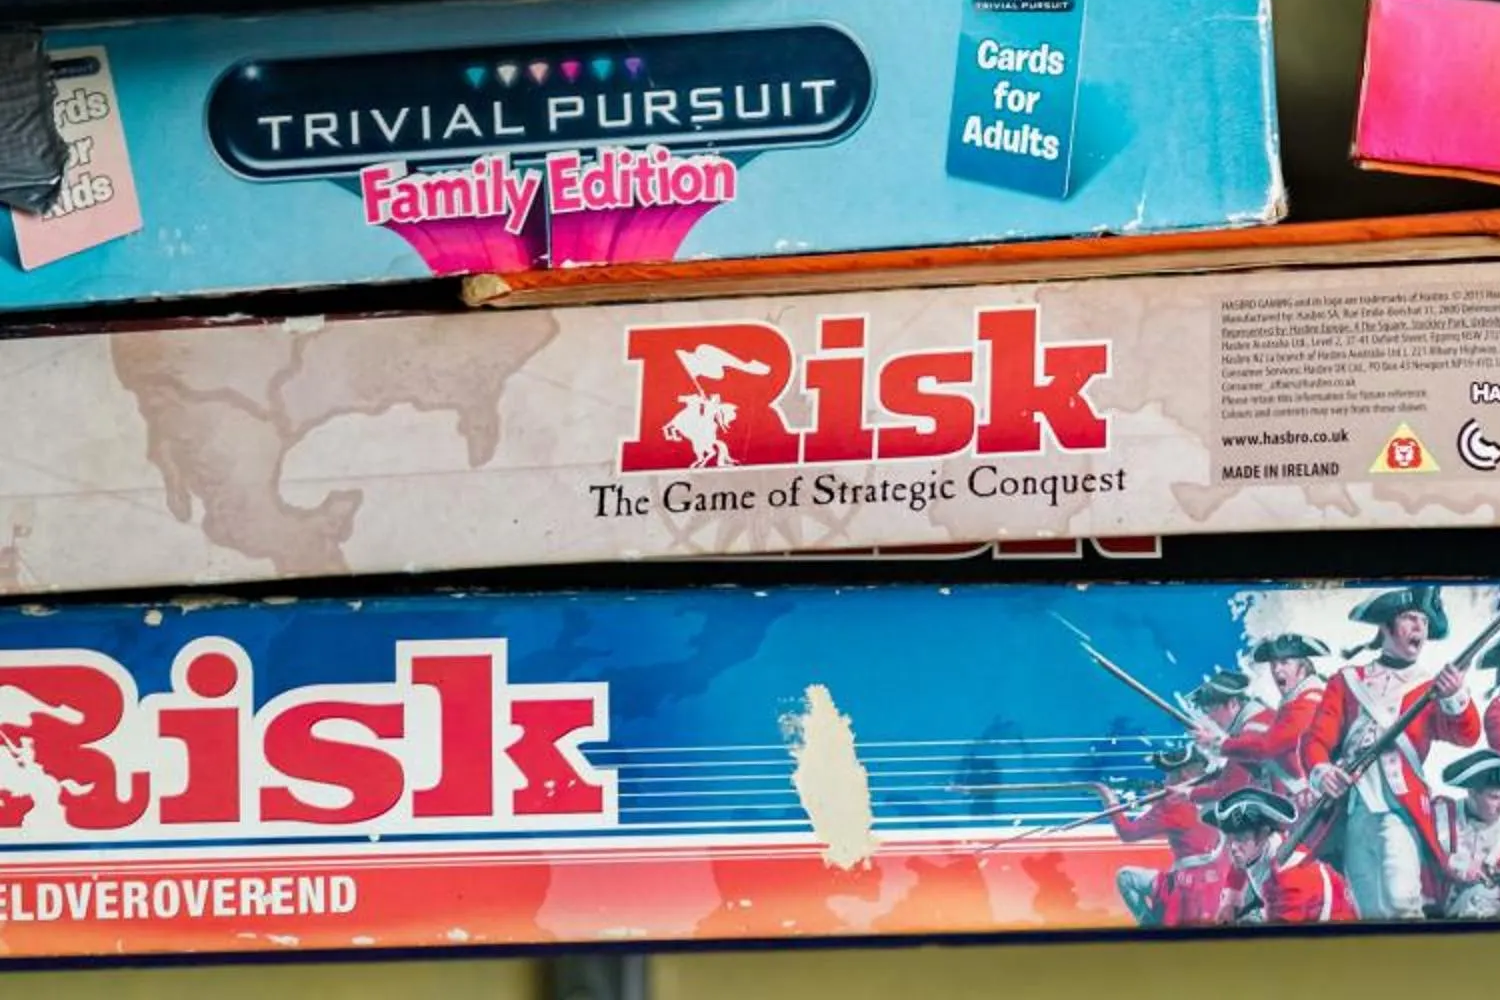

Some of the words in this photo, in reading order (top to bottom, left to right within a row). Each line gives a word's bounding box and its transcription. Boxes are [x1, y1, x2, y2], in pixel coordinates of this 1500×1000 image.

[975, 1, 1019, 10] TRIVIAL
[1021, 1, 1070, 10] PURSUIT
[977, 39, 1065, 75] Cards
[54, 87, 111, 128] rds
[258, 102, 524, 150] TRIVIAL
[548, 79, 836, 132] PURSUIT
[993, 80, 1041, 114] for
[962, 115, 1060, 161] Adults
[358, 150, 542, 236] Family
[544, 143, 739, 215] Edition
[617, 305, 1113, 476] Risk
[1221, 430, 1349, 447] www.hasbro.co.uk
[590, 484, 650, 519] The
[663, 481, 755, 514] Game
[768, 476, 803, 508] of
[813, 469, 956, 511] Strategic
[968, 465, 1127, 508] Conquest
[1222, 464, 1261, 480] MADE
[1264, 463, 1279, 478] IN
[1281, 462, 1339, 478] IRELAND
[0, 875, 357, 922] LDVEROVEREND
